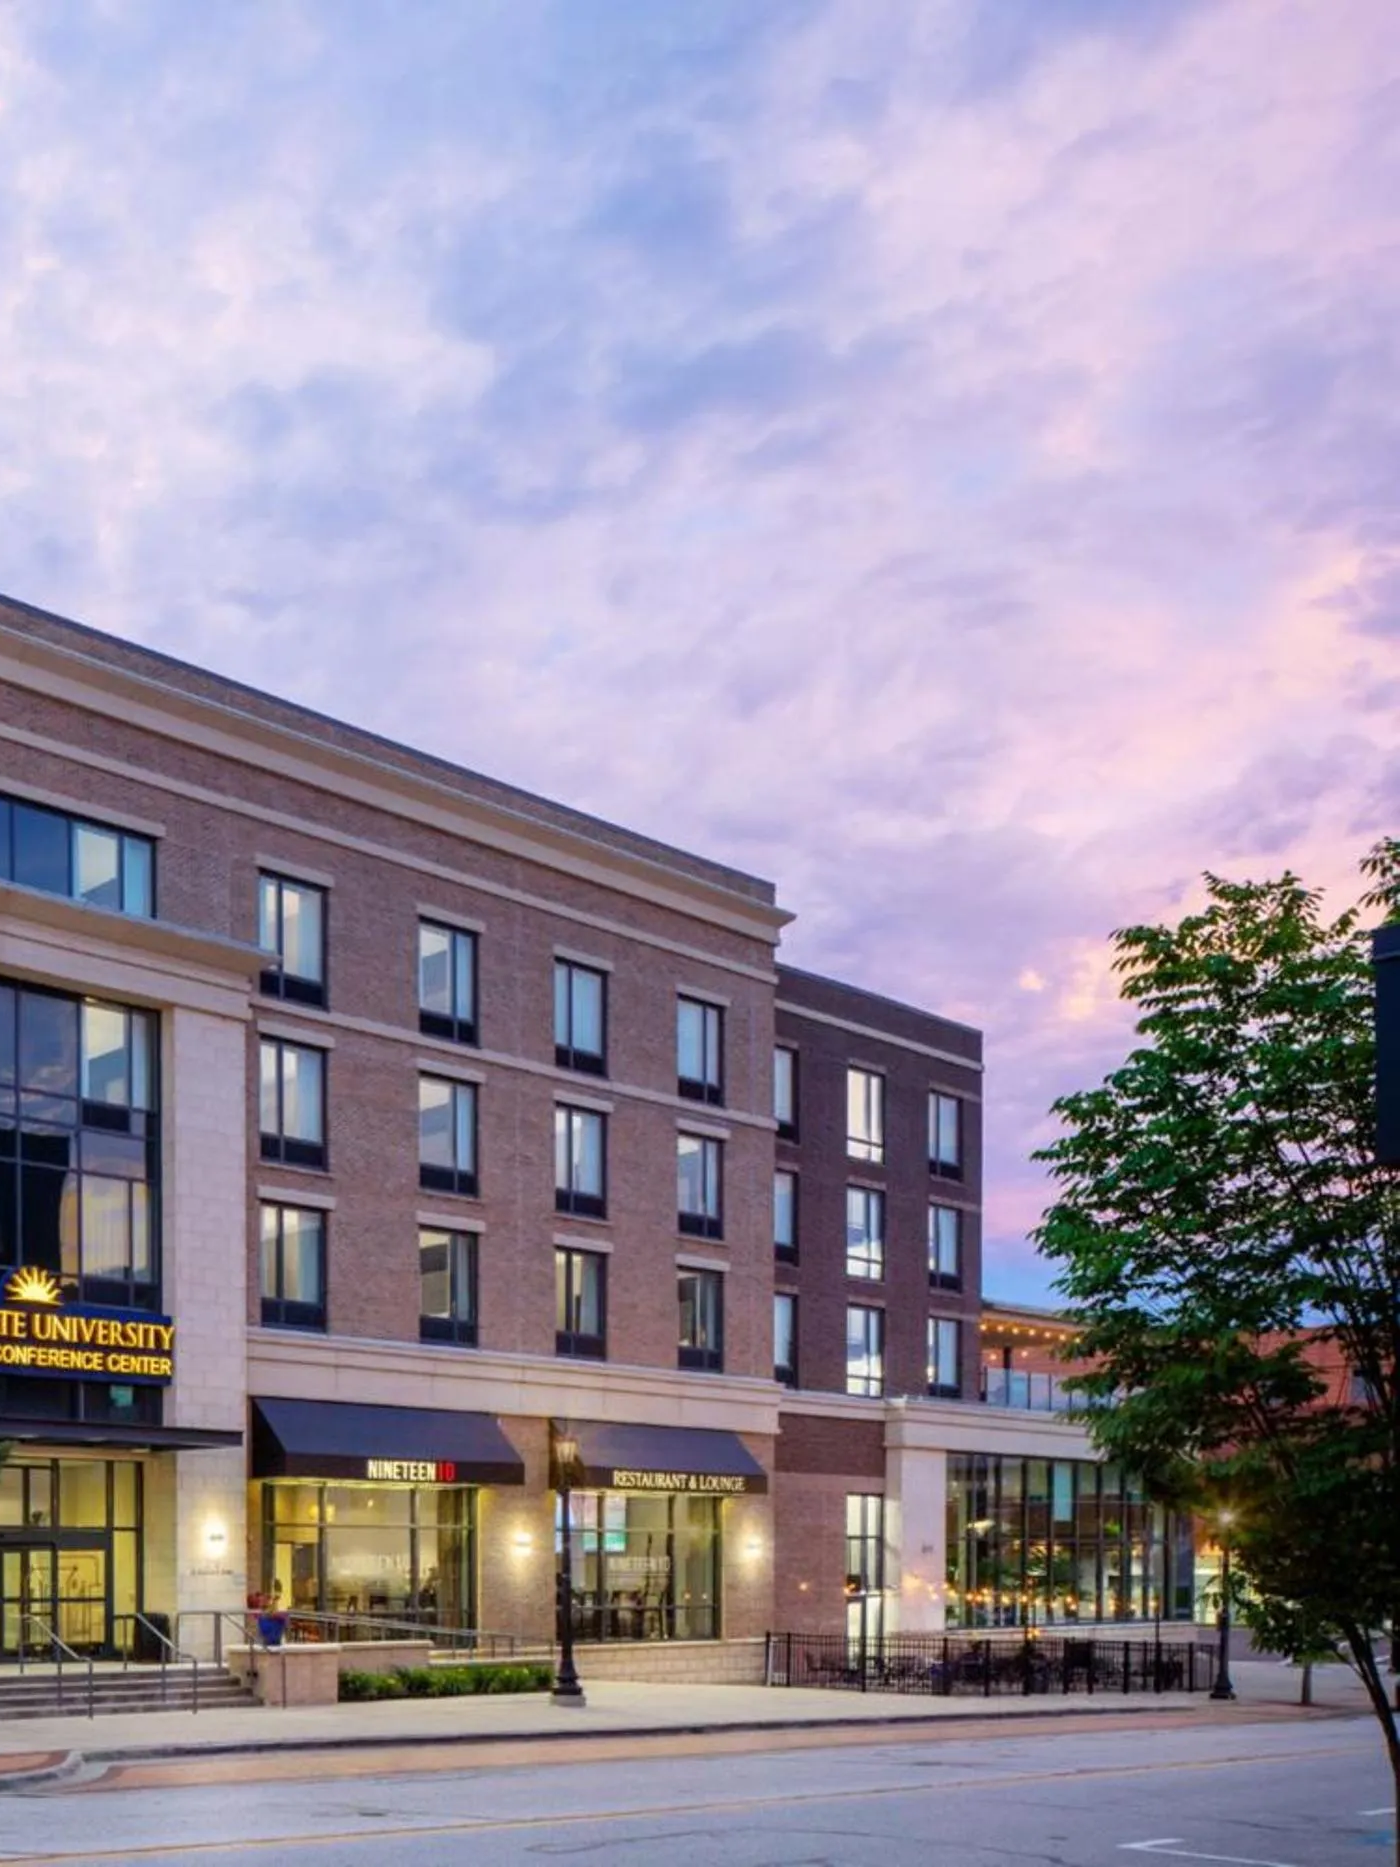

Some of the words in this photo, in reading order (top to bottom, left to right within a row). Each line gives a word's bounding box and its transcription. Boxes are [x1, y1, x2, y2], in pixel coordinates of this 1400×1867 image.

[32, 1312, 175, 1351] UNIVERSITY
[106, 1352, 172, 1376] CENTER
[613, 1470, 688, 1489] RESTAURANT
[689, 1474, 697, 1490] &
[699, 1474, 746, 1491] LOUNGE
